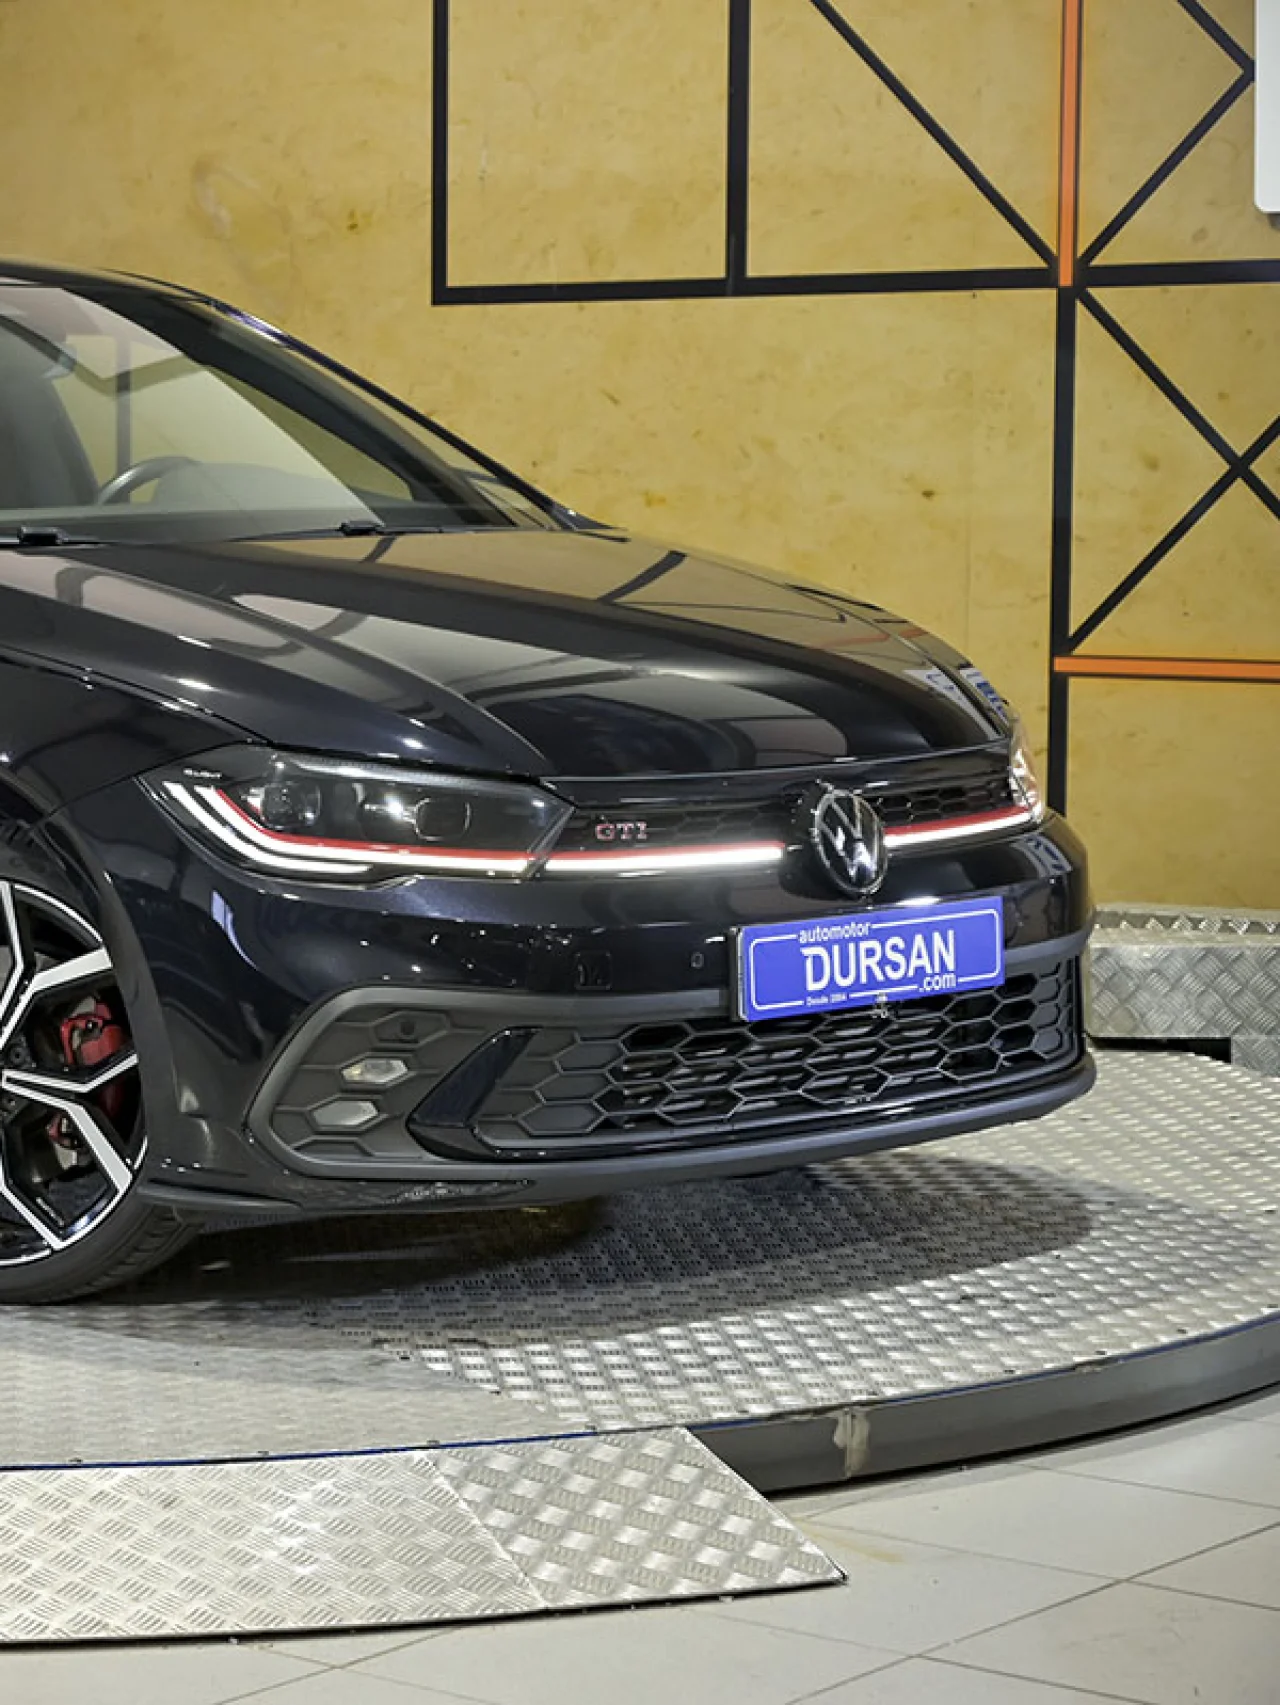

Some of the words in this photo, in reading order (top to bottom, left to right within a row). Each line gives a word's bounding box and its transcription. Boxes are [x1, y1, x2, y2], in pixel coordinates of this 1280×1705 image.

[595, 821, 647, 840] GTI
[798, 921, 870, 943] automotor
[800, 929, 956, 990] DURSAN
[919, 972, 957, 991] .com
